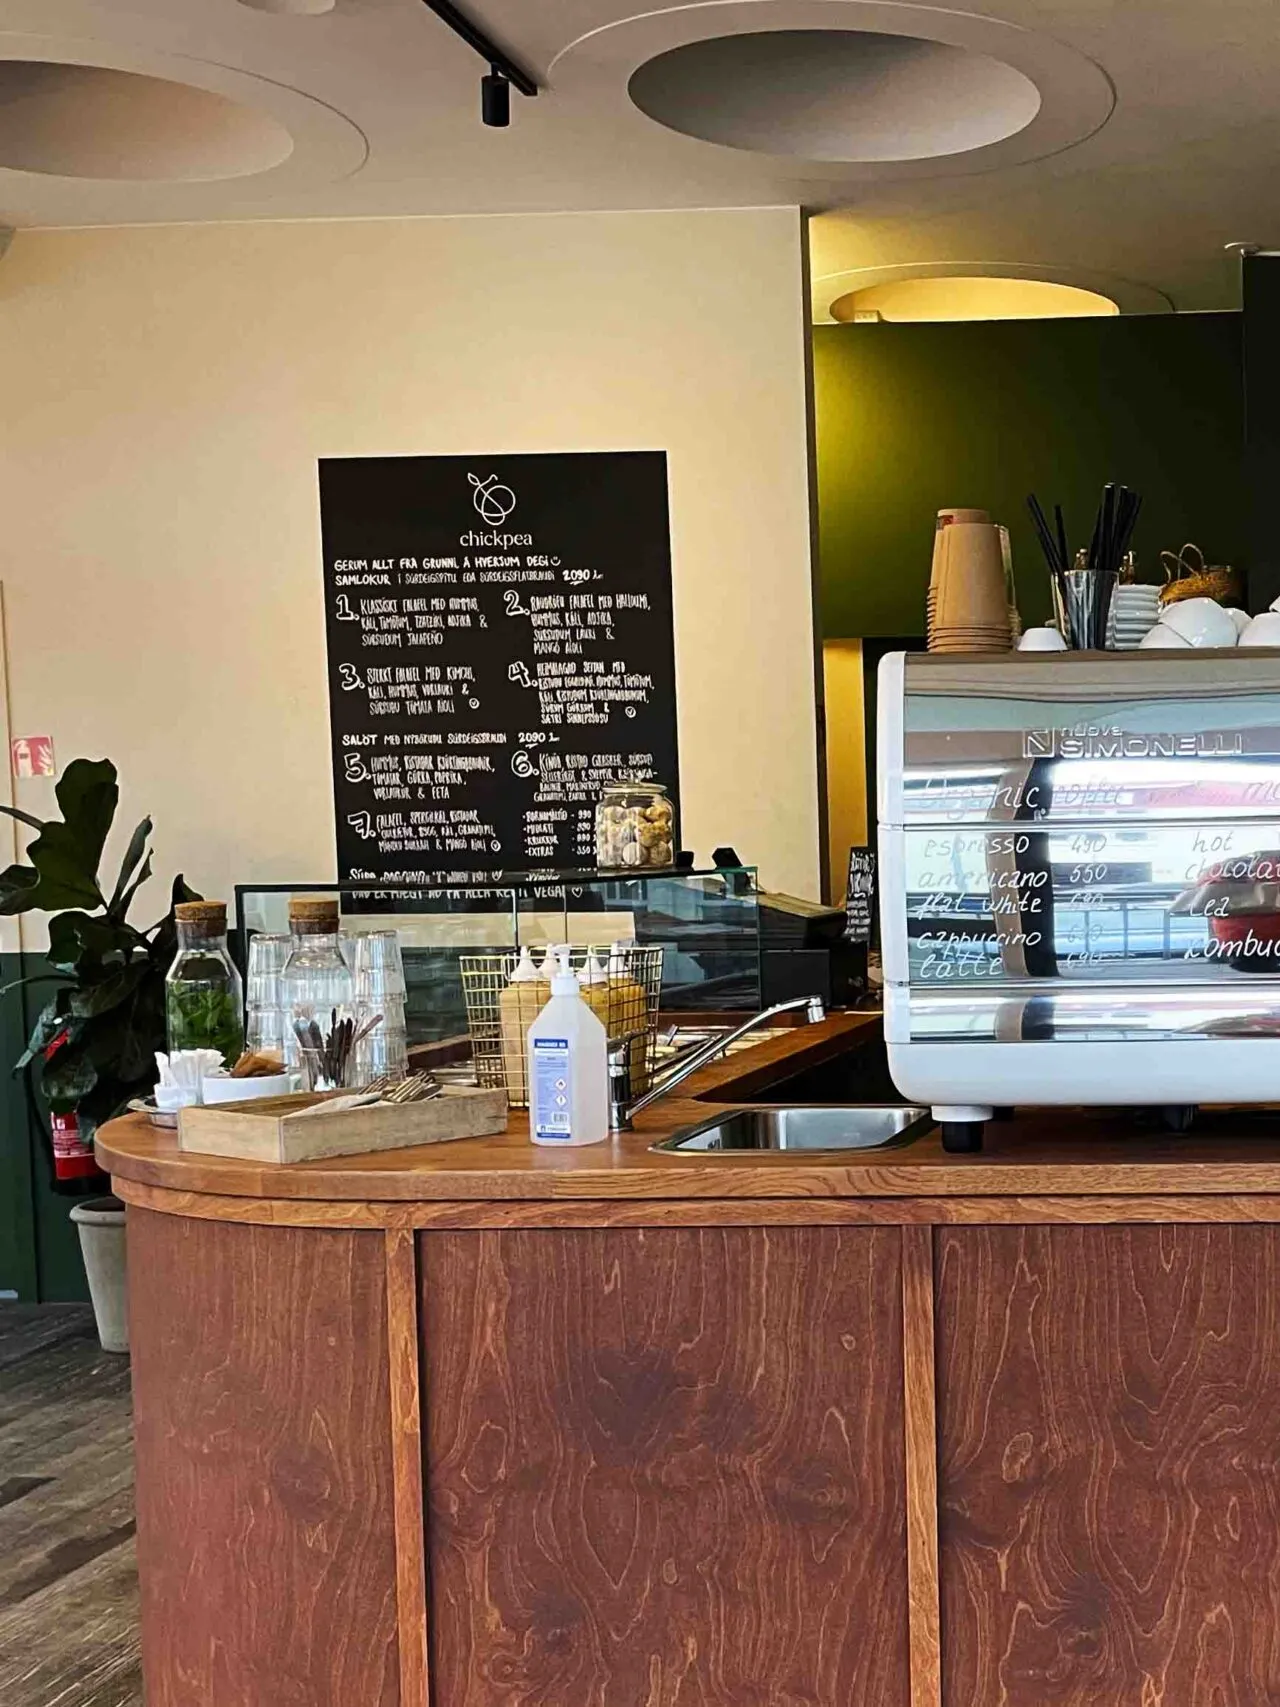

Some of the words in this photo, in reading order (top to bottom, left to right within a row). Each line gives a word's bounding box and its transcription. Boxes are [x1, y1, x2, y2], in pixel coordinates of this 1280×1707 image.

[459, 530, 533, 549] chickpea
[334, 560, 368, 571] GERUM
[372, 559, 394, 570] ALLT
[335, 574, 391, 586] SAMLOKUR
[562, 569, 590, 581] 2090
[479, 614, 488, 628] &
[605, 627, 615, 640] &
[461, 683, 470, 695] &
[518, 732, 545, 743] 2090
[1060, 723, 1123, 737] nuova
[1060, 734, 1243, 757] SIMONELLI
[432, 786, 450, 799] FETA
[924, 835, 1030, 859] espresso
[1192, 831, 1234, 853] hot
[529, 846, 554, 857] EXTRAS
[918, 868, 1049, 888] americano
[1069, 864, 1108, 884] 550
[912, 892, 966, 920] flat
[982, 891, 1043, 915] white
[916, 928, 1042, 961] cappuccino
[920, 953, 1003, 978] latte
